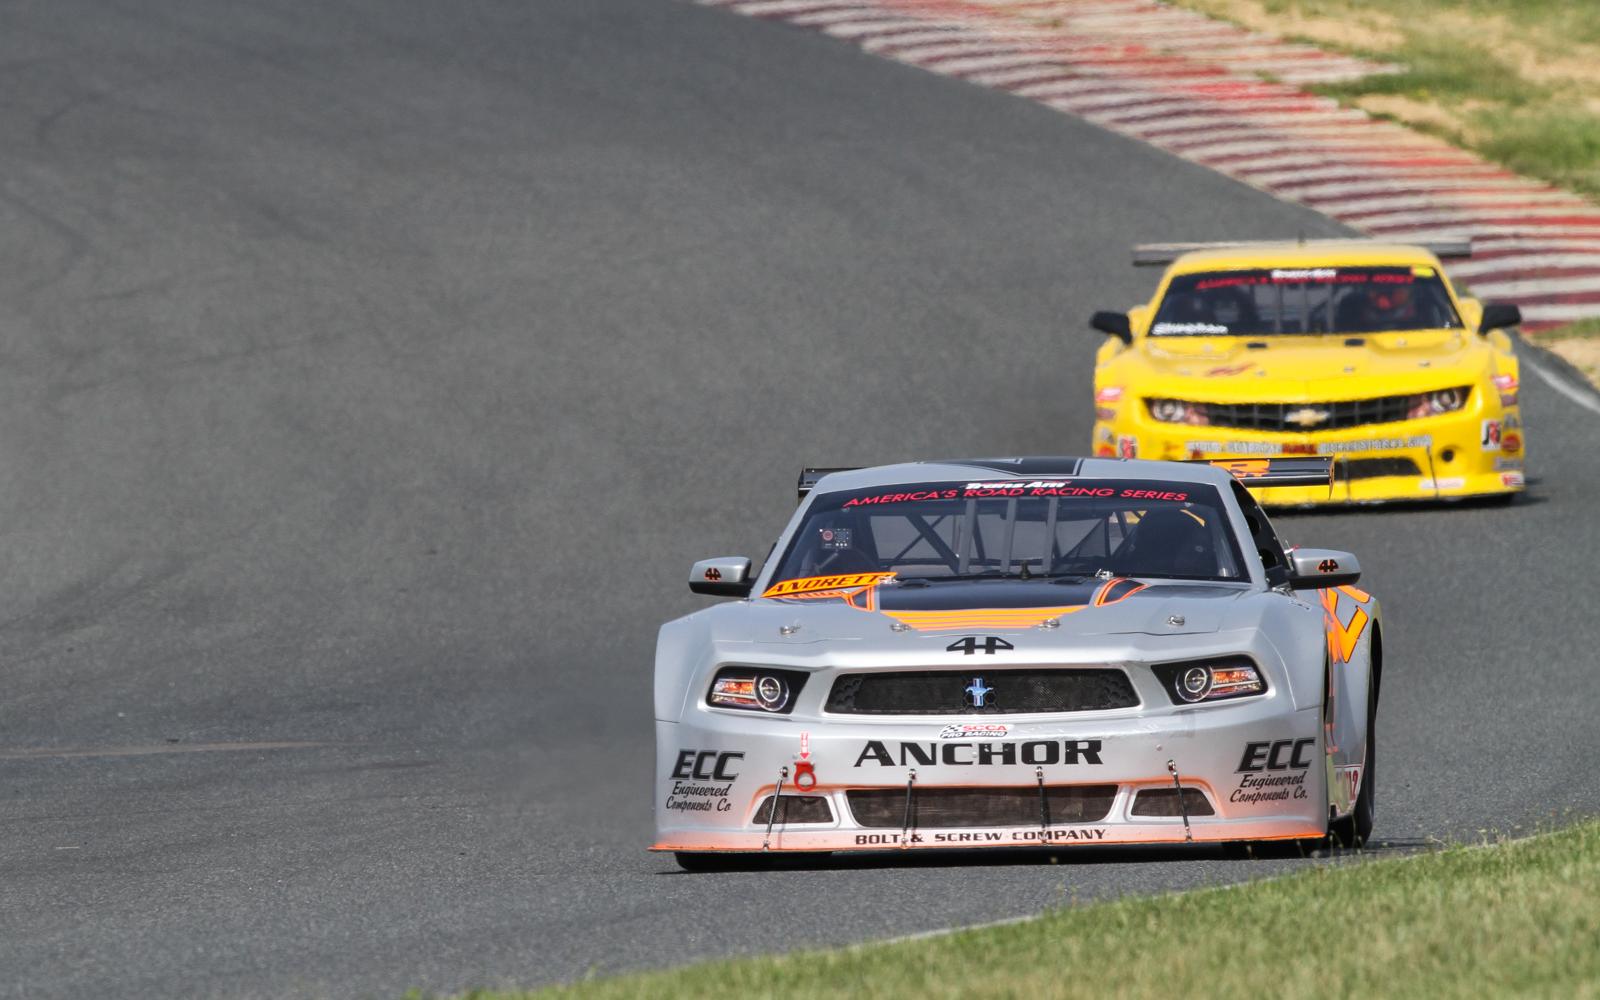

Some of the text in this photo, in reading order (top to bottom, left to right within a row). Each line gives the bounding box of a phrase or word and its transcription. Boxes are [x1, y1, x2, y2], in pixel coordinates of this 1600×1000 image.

[842, 487, 1188, 508] AMERICA'S ROAD RACING SERIES
[853, 739, 1104, 767] ANCHOR
[1234, 737, 1316, 774] ECC
[669, 750, 745, 782] ECC
[672, 781, 732, 798] Engineered
[1239, 771, 1307, 790] Engineered
[666, 796, 712, 812] Components
[1230, 786, 1289, 805] Components
[855, 828, 1106, 846] BOLT & SCREW COMPANY
